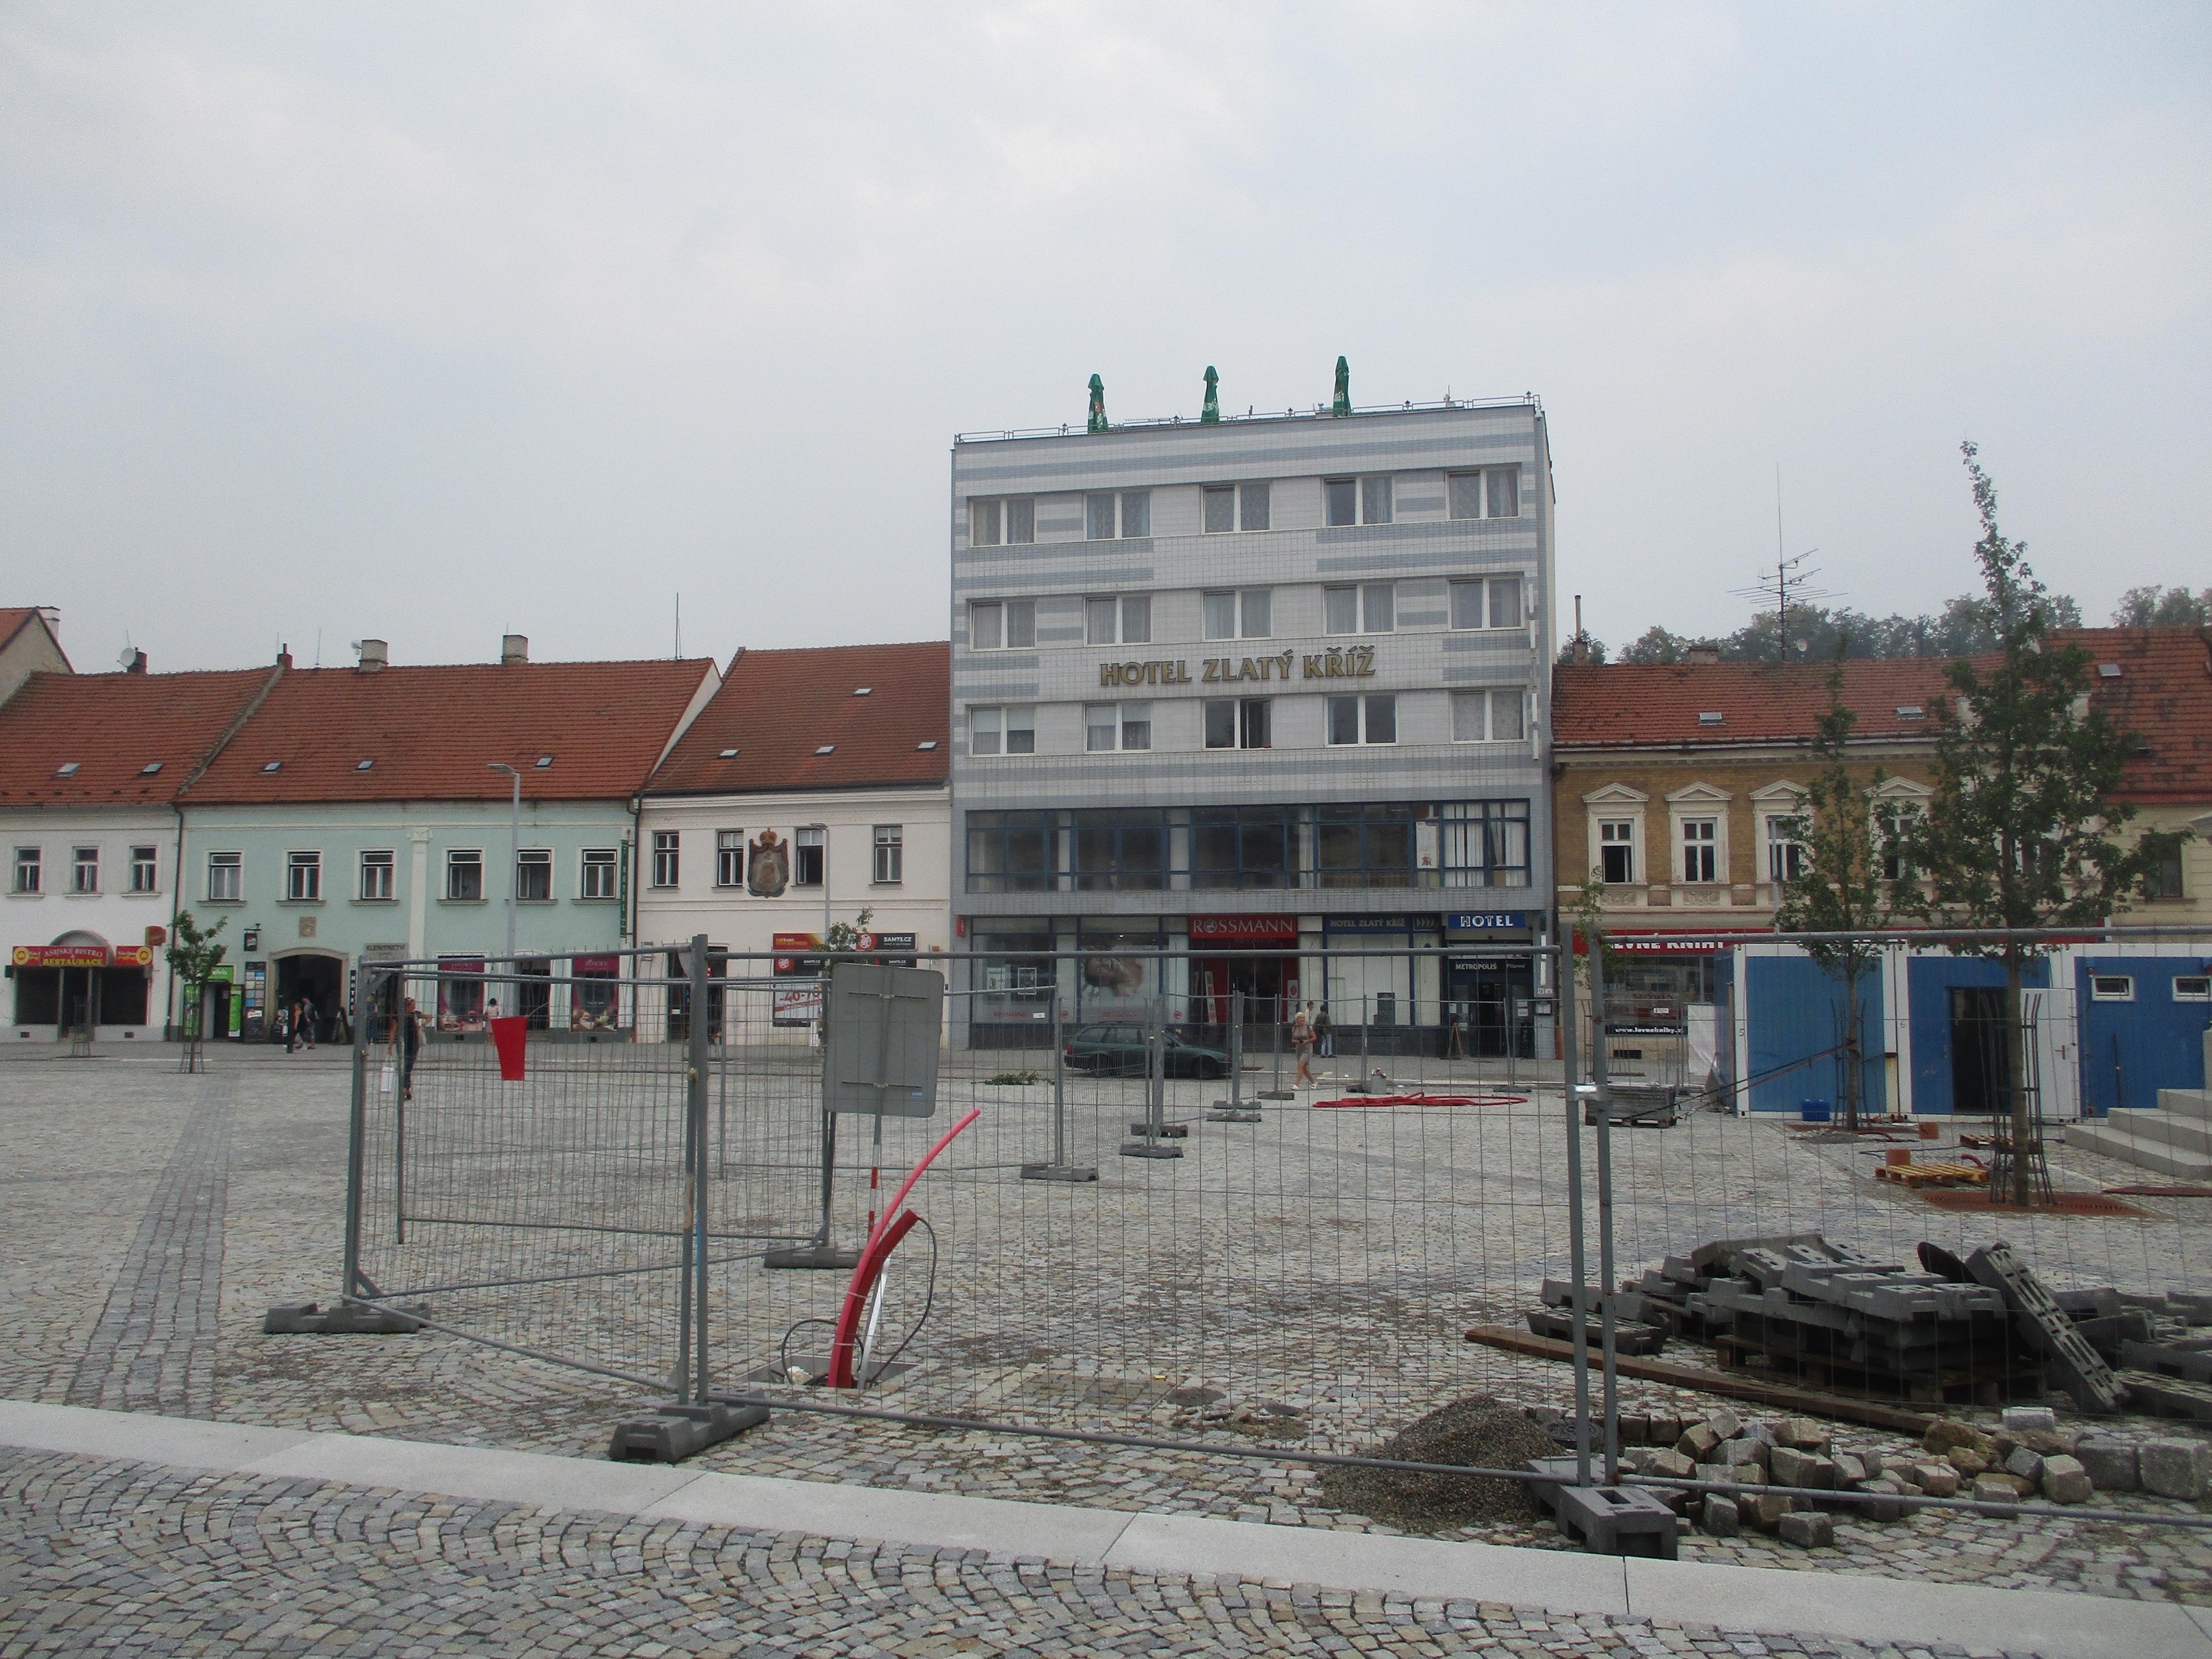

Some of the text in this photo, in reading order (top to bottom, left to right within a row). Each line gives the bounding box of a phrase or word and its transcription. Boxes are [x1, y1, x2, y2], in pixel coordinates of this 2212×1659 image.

[1100, 645, 1376, 686] HOTEL ZLATÝ KŘÍŽ
[1193, 919, 1292, 933] ROSSMANN
[1460, 915, 1513, 927] HOTEL
[75, 948, 103, 957] BISTRO
[1739, 1028, 1745, 1037] 5
